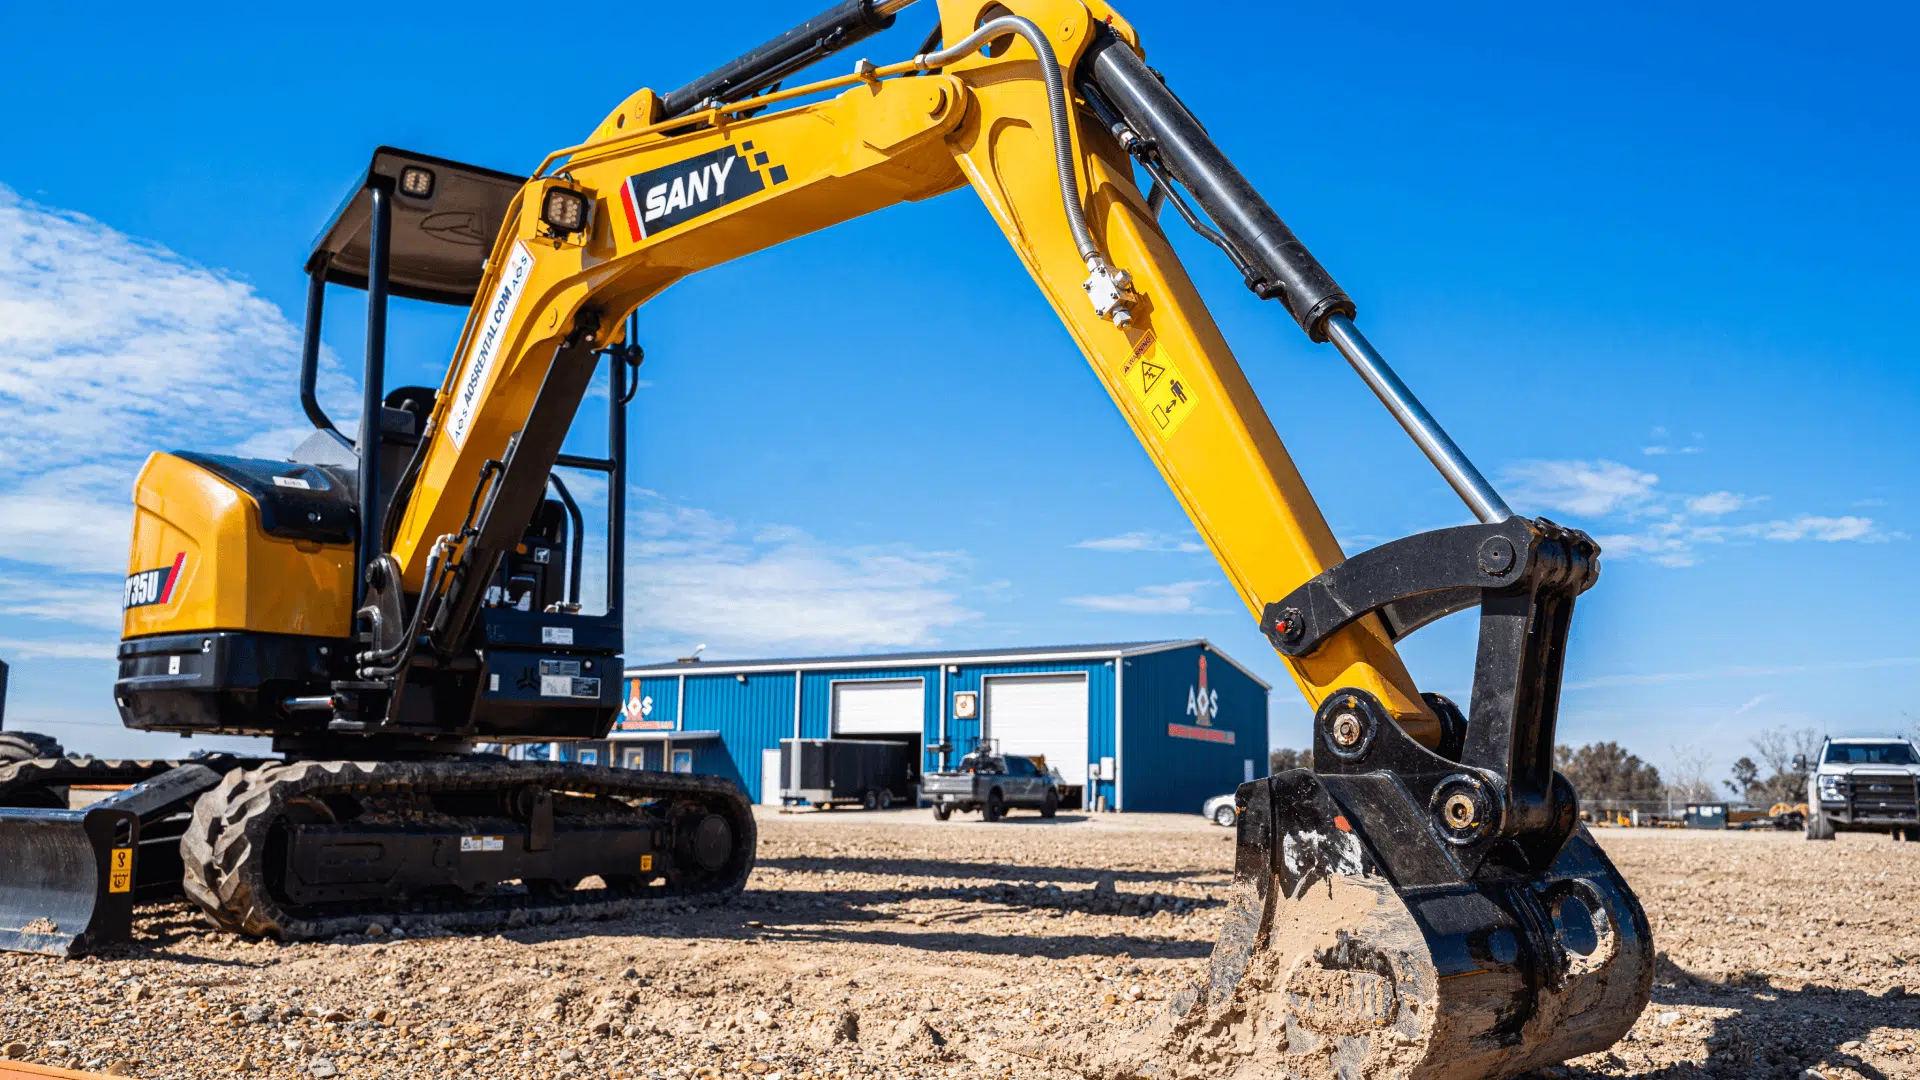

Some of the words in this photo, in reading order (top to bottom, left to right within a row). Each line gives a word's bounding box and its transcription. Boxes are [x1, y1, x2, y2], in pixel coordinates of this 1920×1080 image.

[645, 155, 736, 223] SANY
[466, 285, 513, 408] AOSRENTAL.COM
[1128, 336, 1151, 366] WARNING
[1186, 684, 1218, 719] AOS
